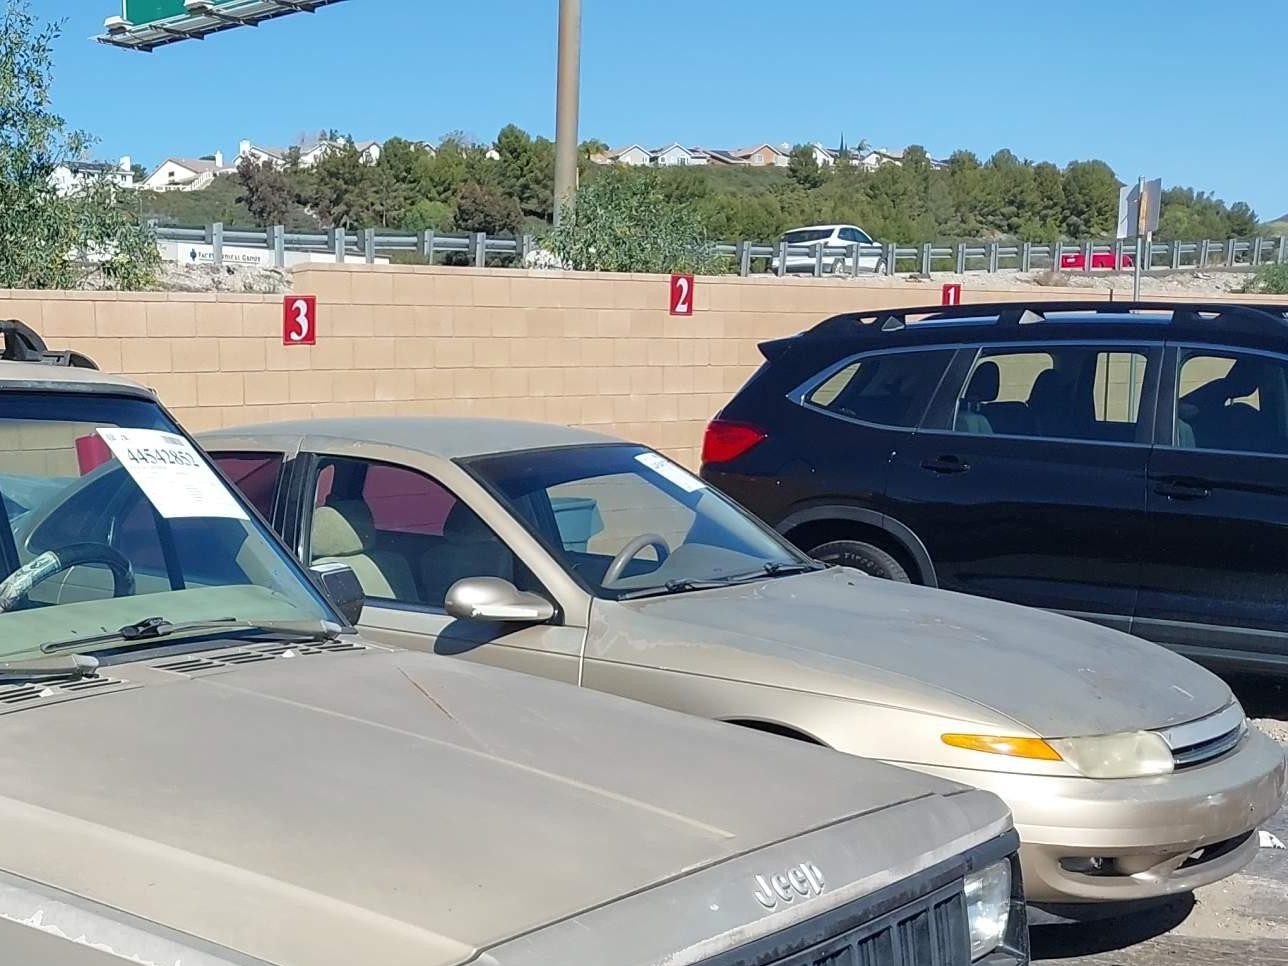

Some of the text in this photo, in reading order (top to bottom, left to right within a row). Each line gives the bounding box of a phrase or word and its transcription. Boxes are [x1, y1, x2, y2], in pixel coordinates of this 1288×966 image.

[675, 277, 689, 312] 2
[947, 287, 955, 305] 1
[290, 299, 309, 341] 3
[127, 448, 200, 468] 44542852
[753, 862, 824, 911] Jeep
